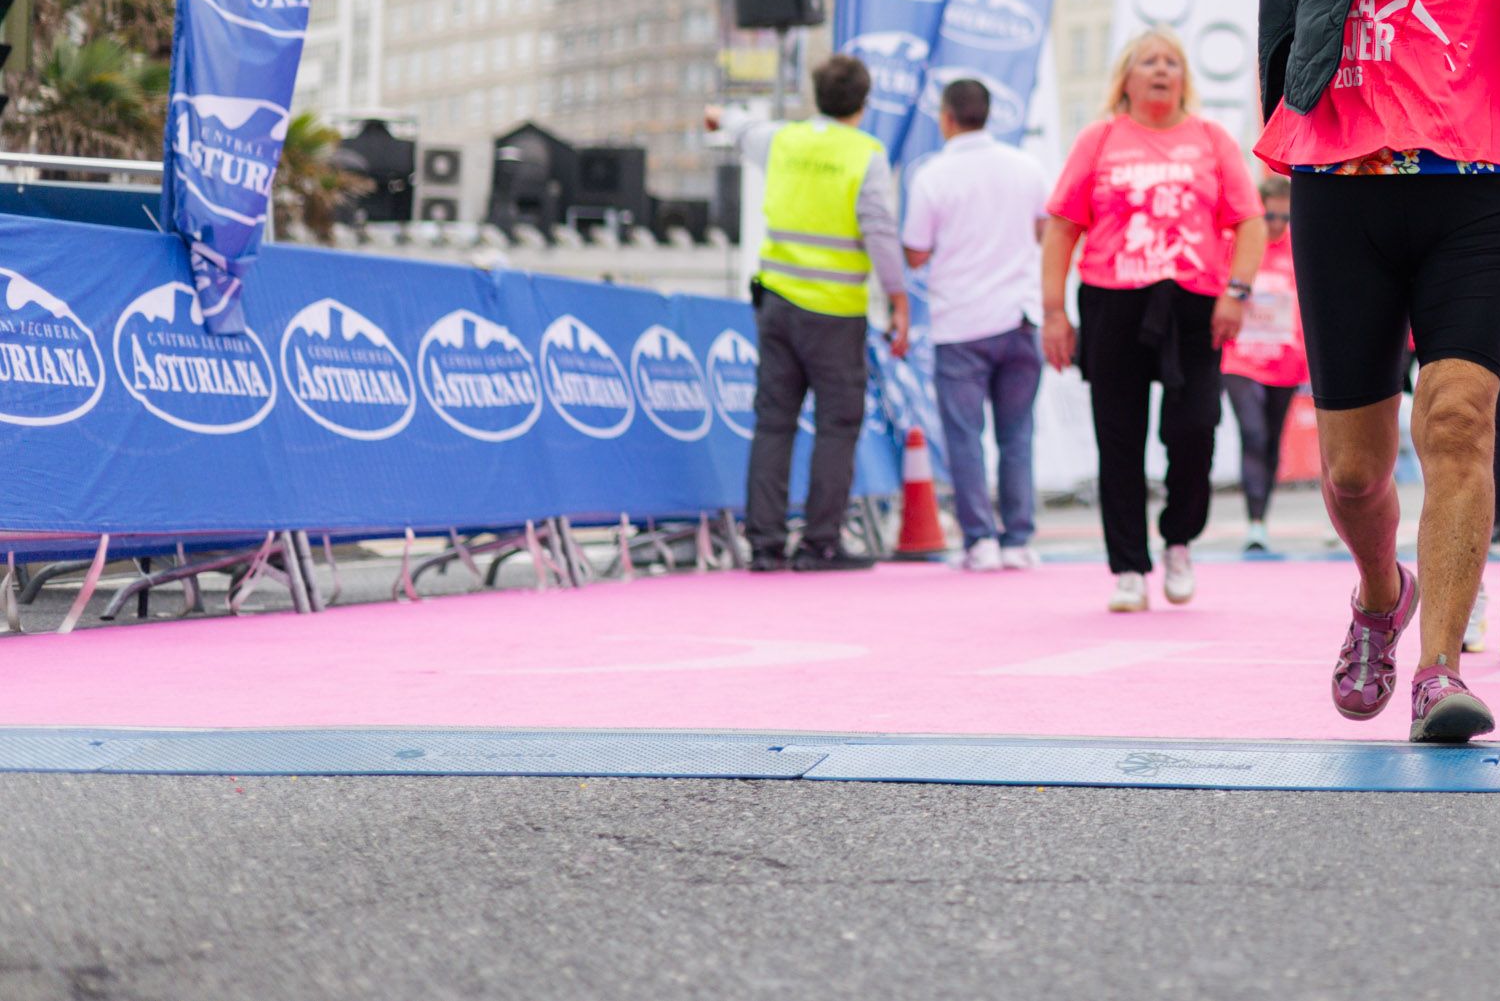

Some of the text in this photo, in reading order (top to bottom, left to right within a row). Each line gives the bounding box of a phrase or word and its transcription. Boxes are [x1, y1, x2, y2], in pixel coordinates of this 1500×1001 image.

[1341, 17, 1396, 63] JER
[20, 320, 80, 341] LECHERA
[131, 332, 271, 398] ASTURIANA
[295, 344, 410, 406] ASTURIANA
